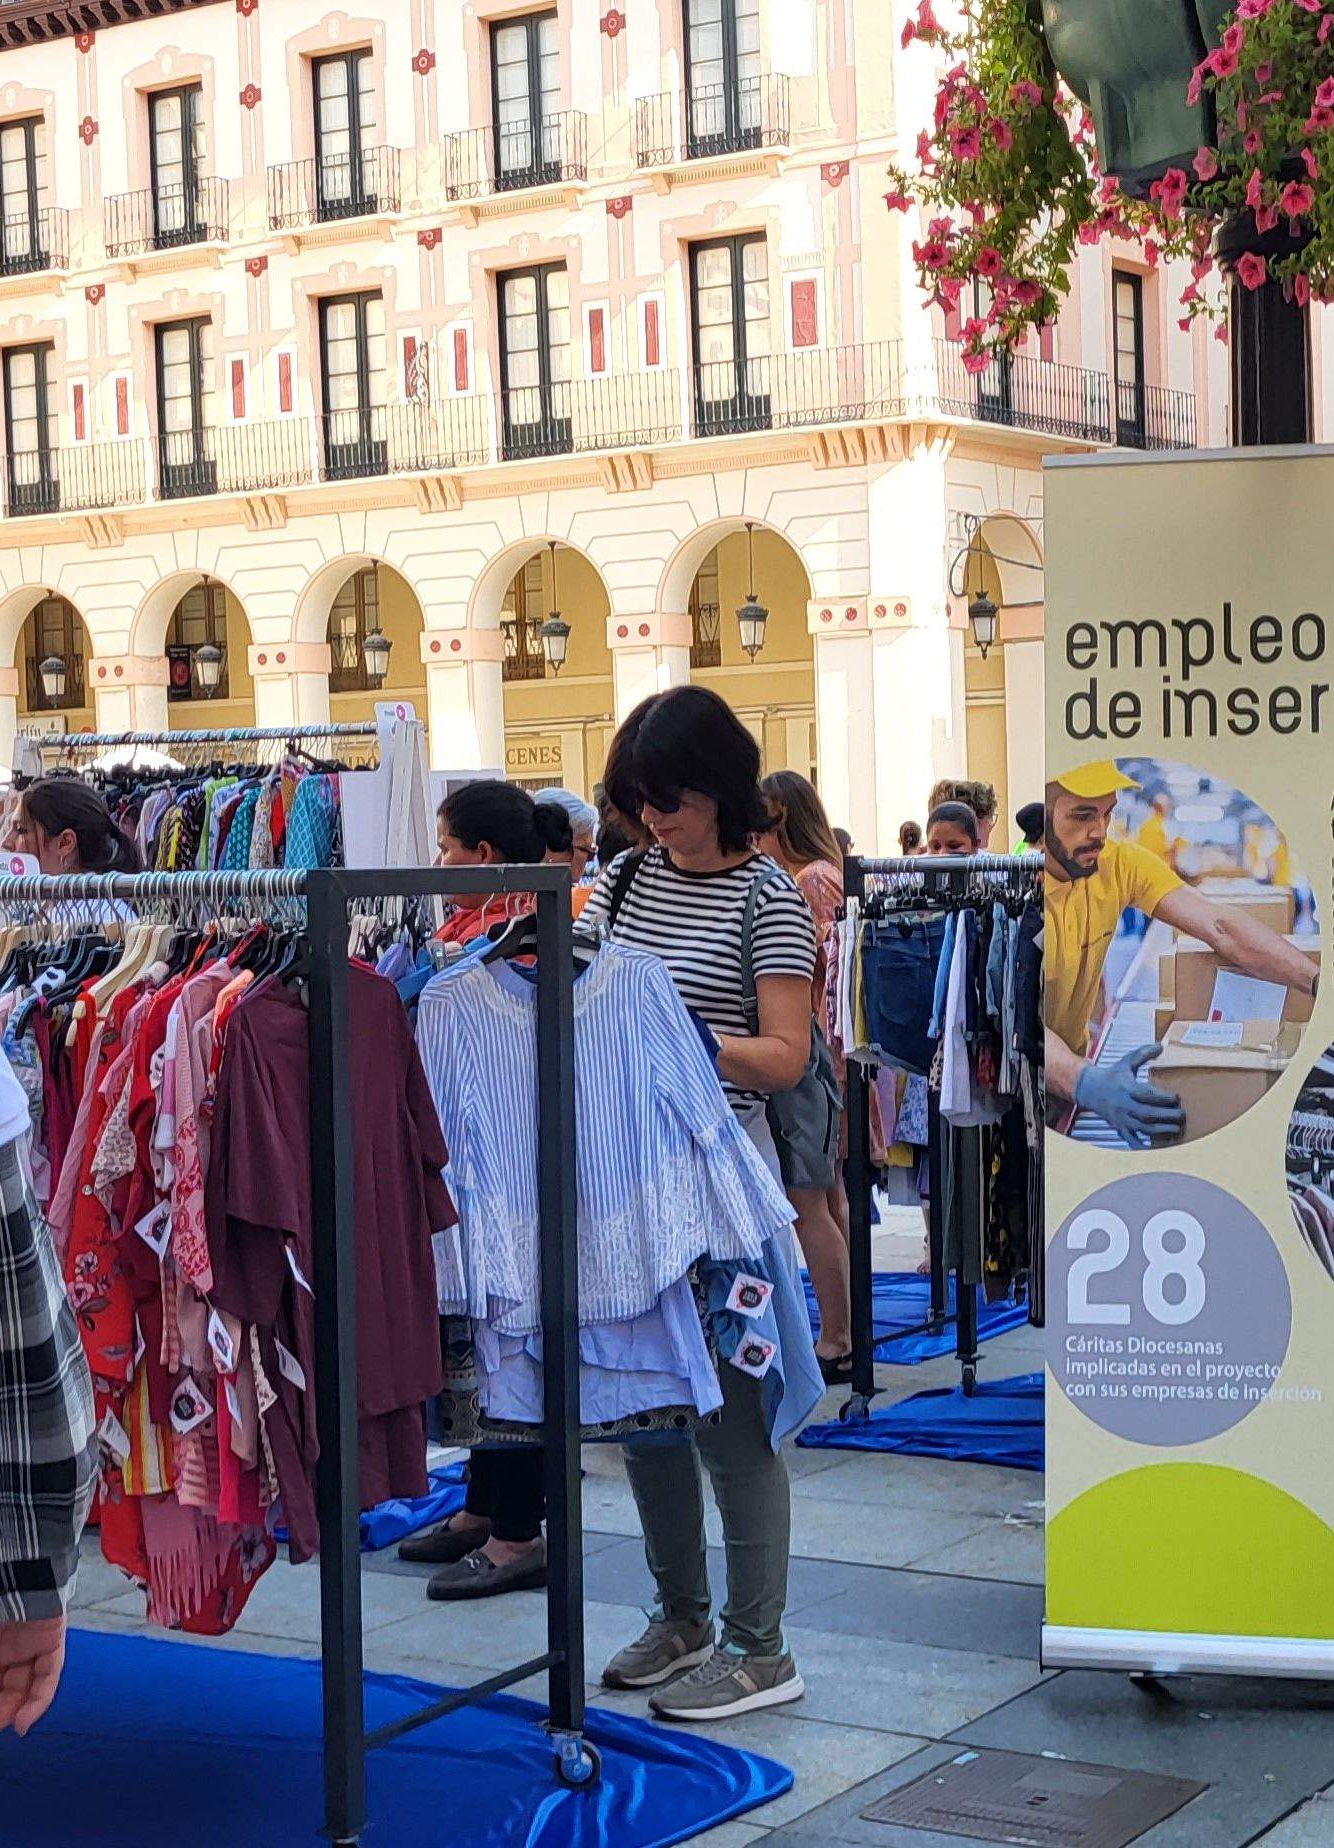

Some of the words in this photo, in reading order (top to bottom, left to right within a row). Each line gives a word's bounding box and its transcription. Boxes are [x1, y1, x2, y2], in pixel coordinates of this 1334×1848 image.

[1066, 602, 1326, 680] empleo
[1065, 677, 1142, 740] de
[505, 745, 562, 765] CENES
[1066, 1208, 1206, 1326] 28
[1065, 1334, 1124, 1354] Cáritas
[1128, 1335, 1224, 1356] Diocesanas
[1065, 1358, 1157, 1379] implicadas
[1160, 1362, 1182, 1377] en
[1185, 1358, 1202, 1377] el
[1205, 1361, 1283, 1383] proyecto
[1065, 1382, 1097, 1397] con
[1100, 1384, 1128, 1398] sus
[1131, 1383, 1214, 1402] empresas
[1217, 1381, 1240, 1399] de
[1243, 1381, 1322, 1402] inserción
